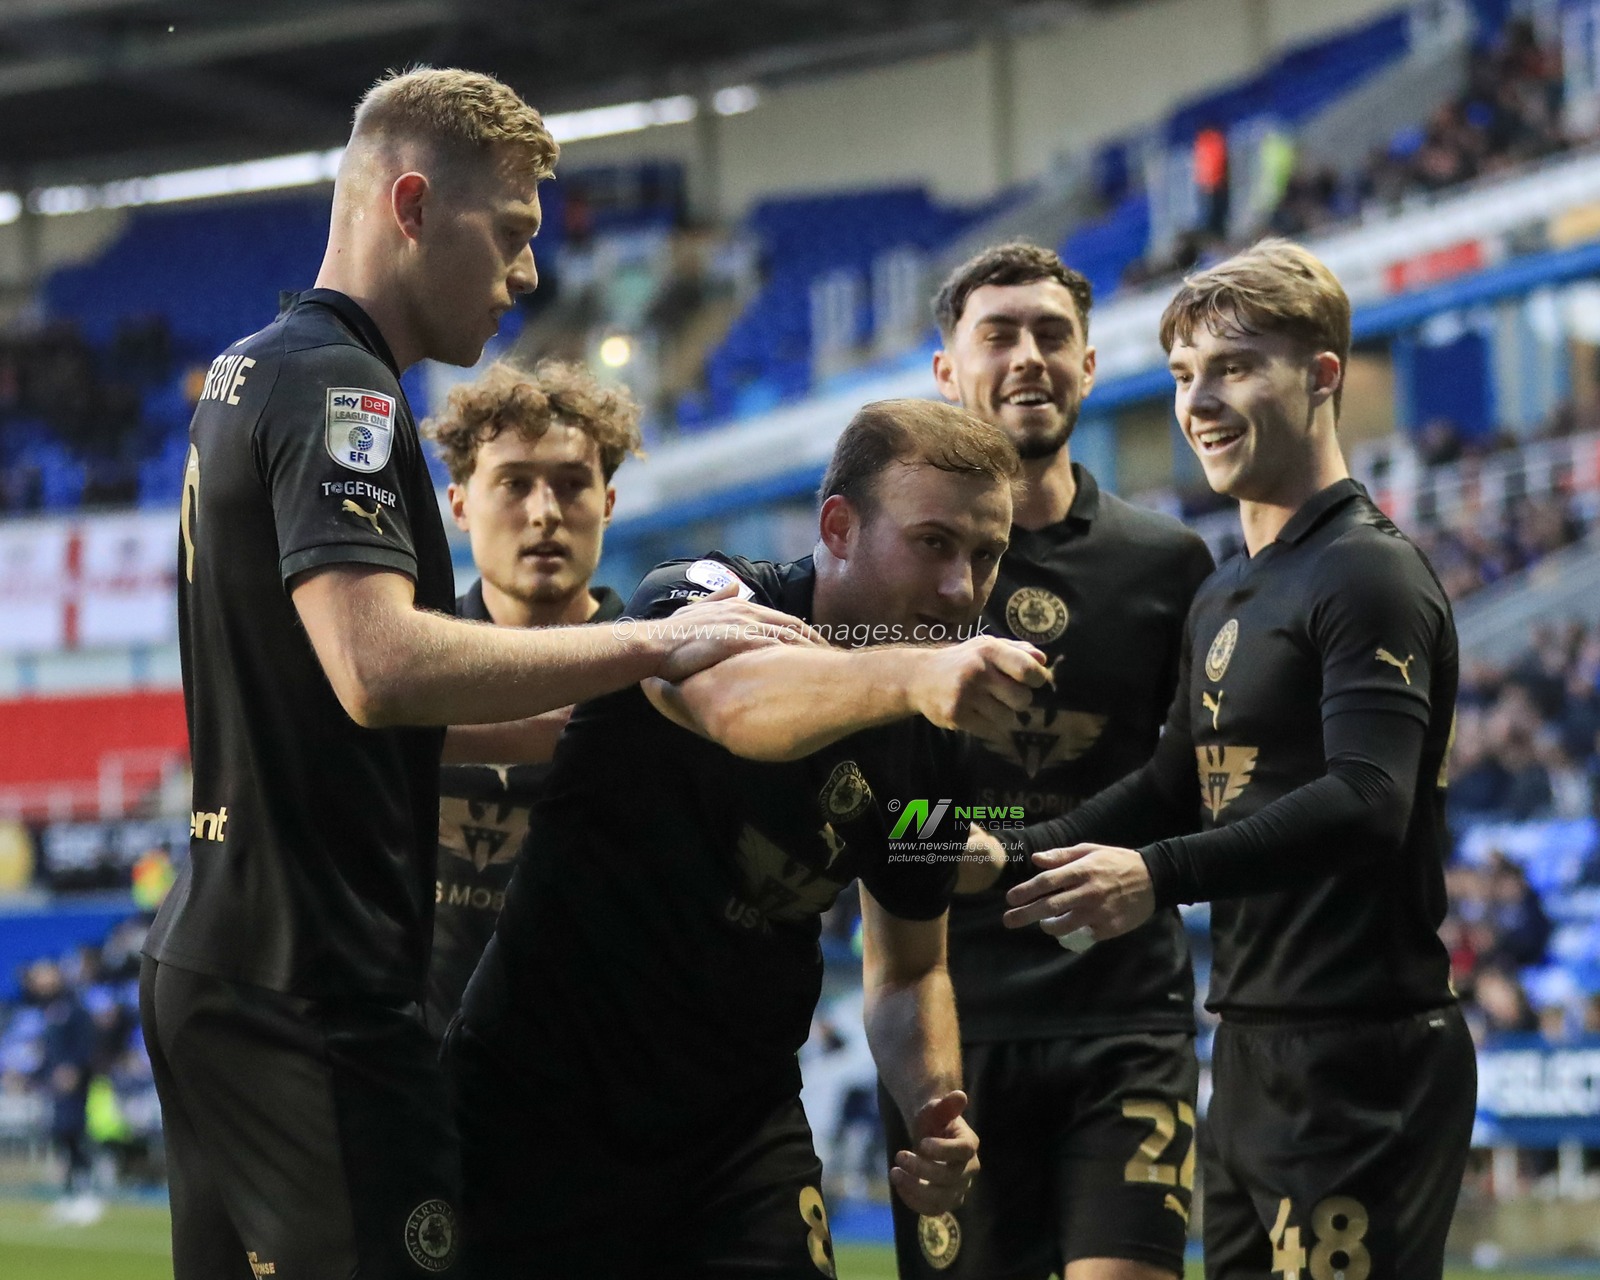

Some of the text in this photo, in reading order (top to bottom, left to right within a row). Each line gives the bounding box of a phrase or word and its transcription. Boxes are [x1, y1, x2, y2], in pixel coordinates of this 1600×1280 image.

[200, 354, 257, 406] ROVE
[334, 395, 387, 412] sky bet
[335, 411, 388, 427] LEAGUE ONE
[350, 451, 370, 466] EFL
[1270, 1195, 1371, 1280] 48
